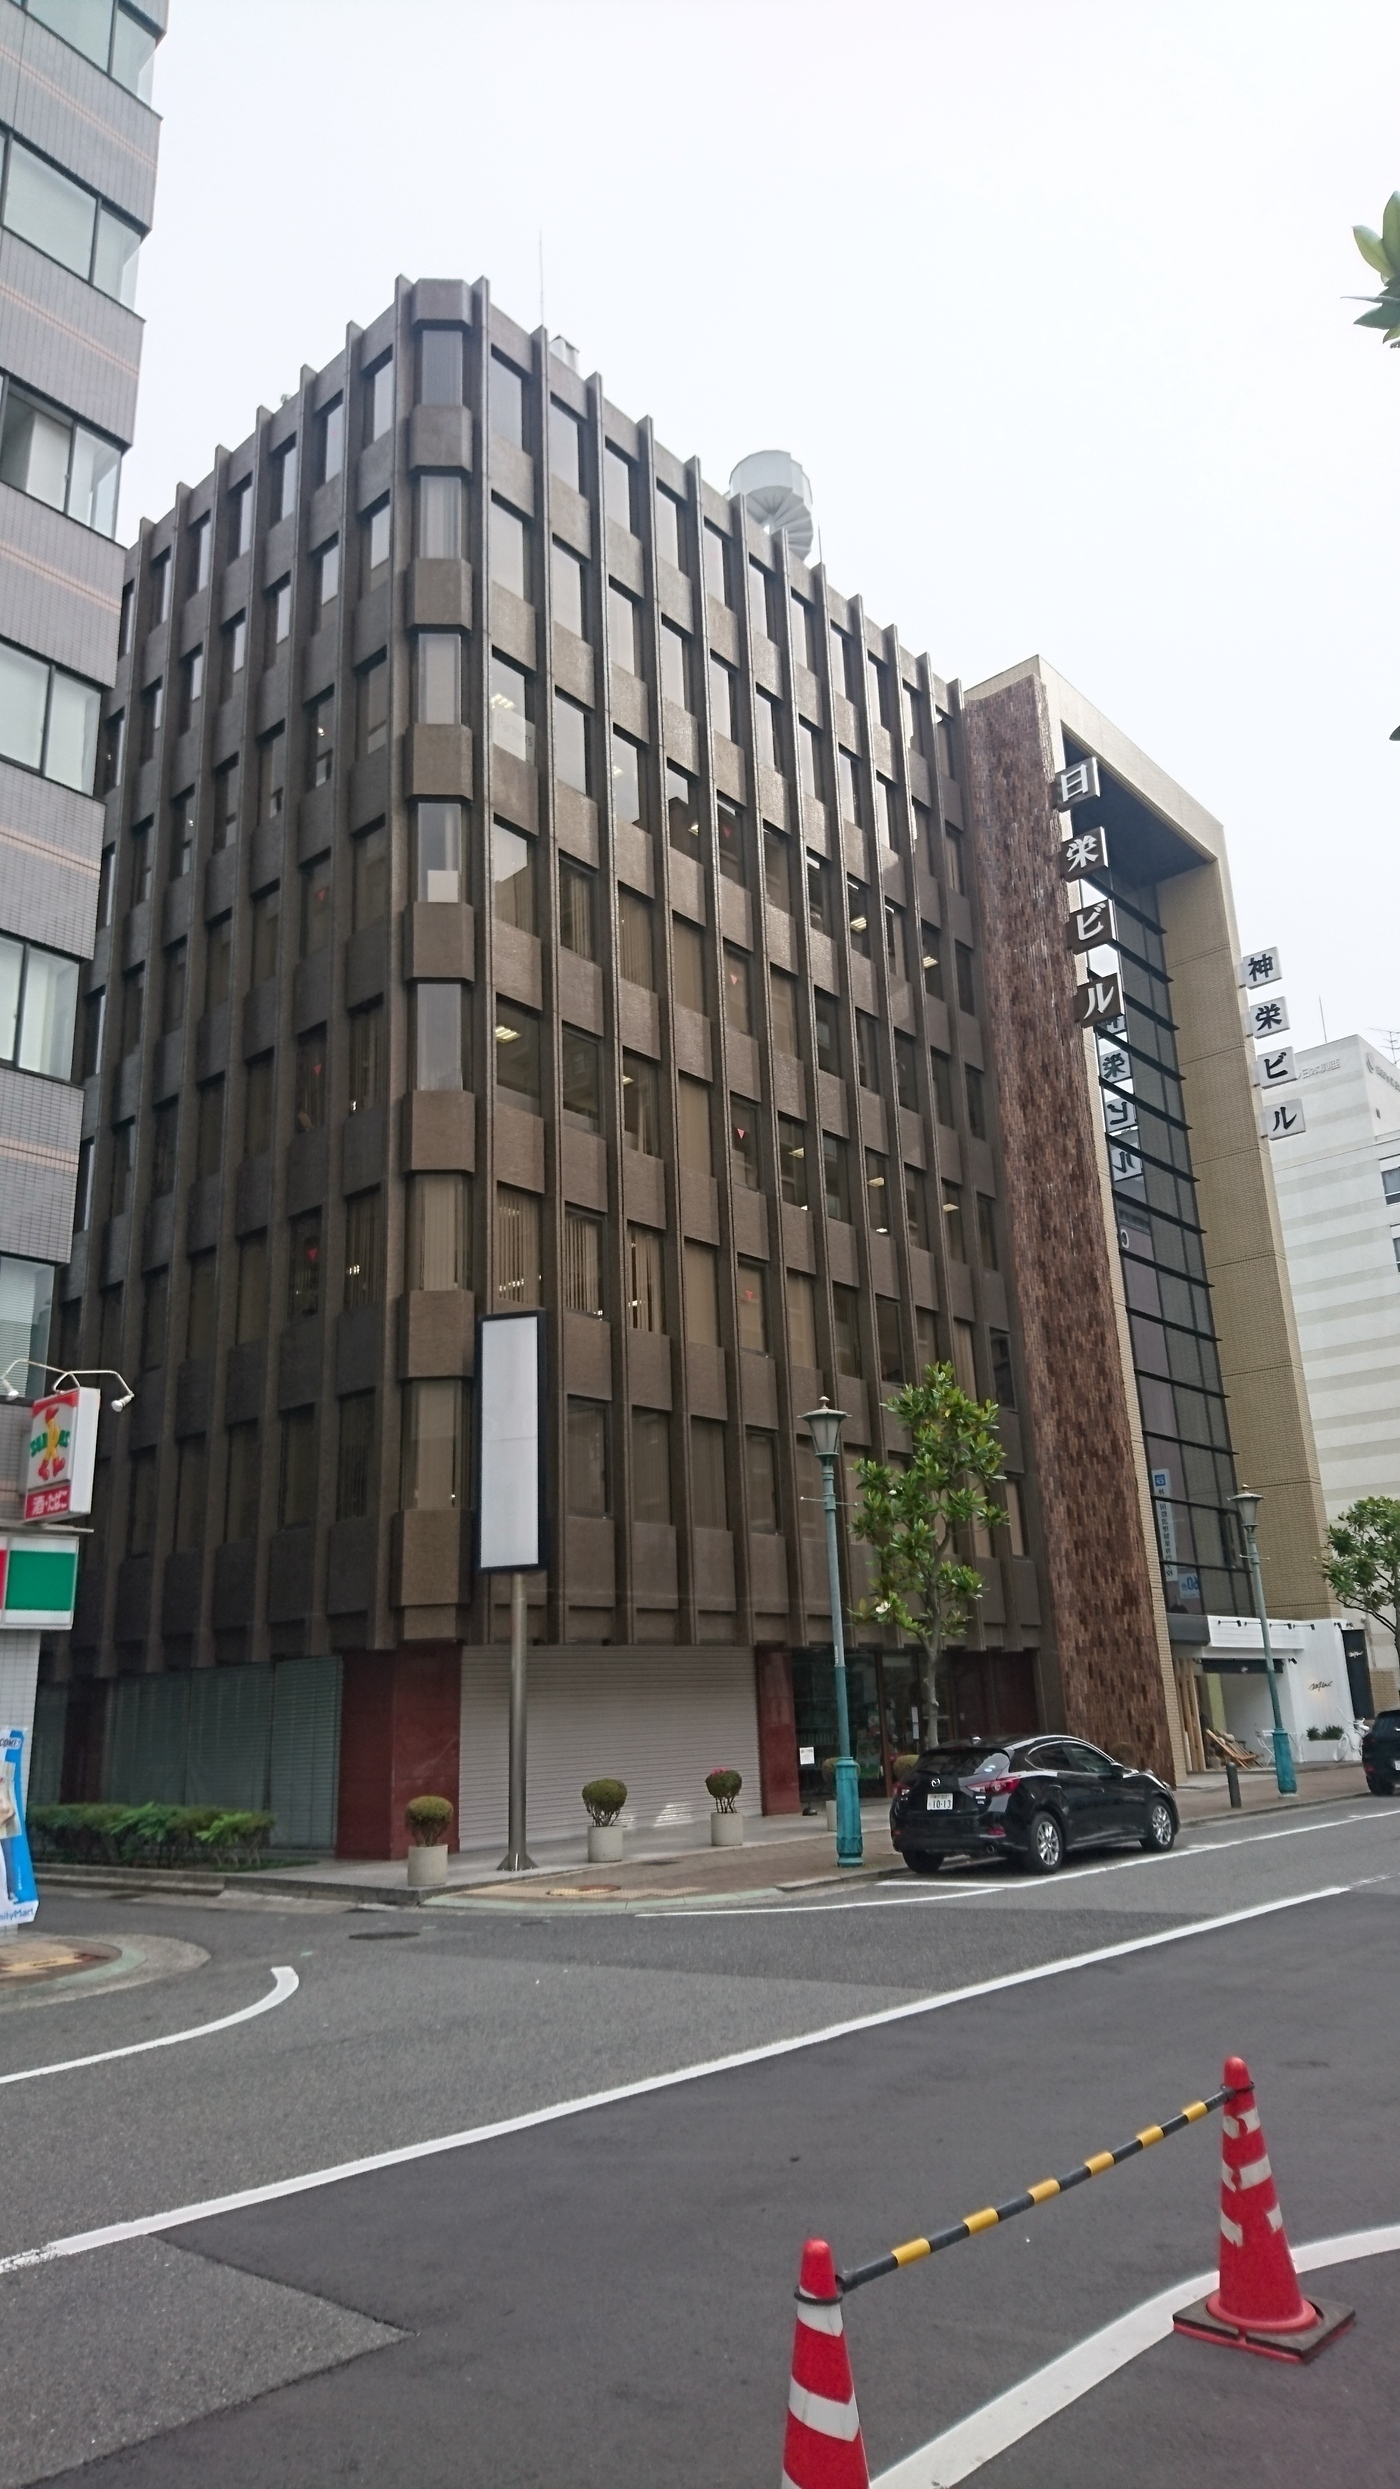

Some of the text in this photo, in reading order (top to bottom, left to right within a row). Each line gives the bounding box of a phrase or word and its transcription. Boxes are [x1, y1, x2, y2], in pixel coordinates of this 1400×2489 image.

[1060, 764, 1114, 1020] 日栄ビル
[1248, 953, 1297, 1132] 神栄ビル
